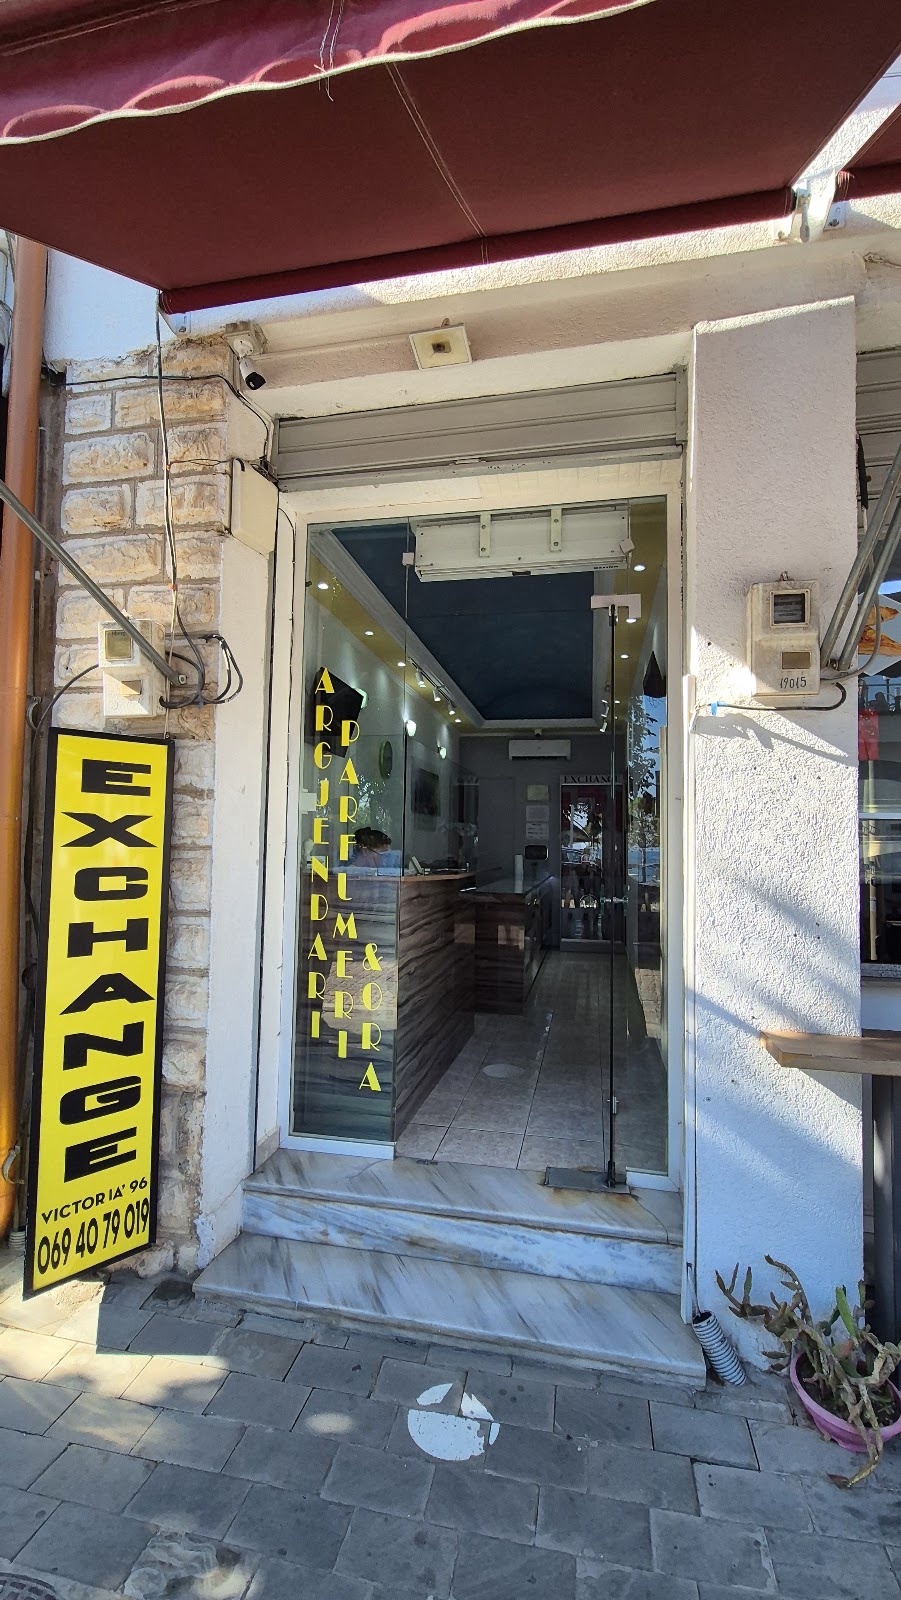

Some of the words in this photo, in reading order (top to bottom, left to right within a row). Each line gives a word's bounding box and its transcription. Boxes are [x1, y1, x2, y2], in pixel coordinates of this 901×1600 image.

[308, 667, 334, 1038] ARGJENDARI
[60, 758, 157, 1184] EXCHANGE
[362, 942, 384, 971] &
[358, 982, 383, 1092] ORA
[129, 1176, 148, 1194] 96
[37, 1227, 72, 1275] 069
[75, 1217, 99, 1258] 40
[103, 1208, 121, 1249] 79
[124, 1197, 150, 1239] 019
